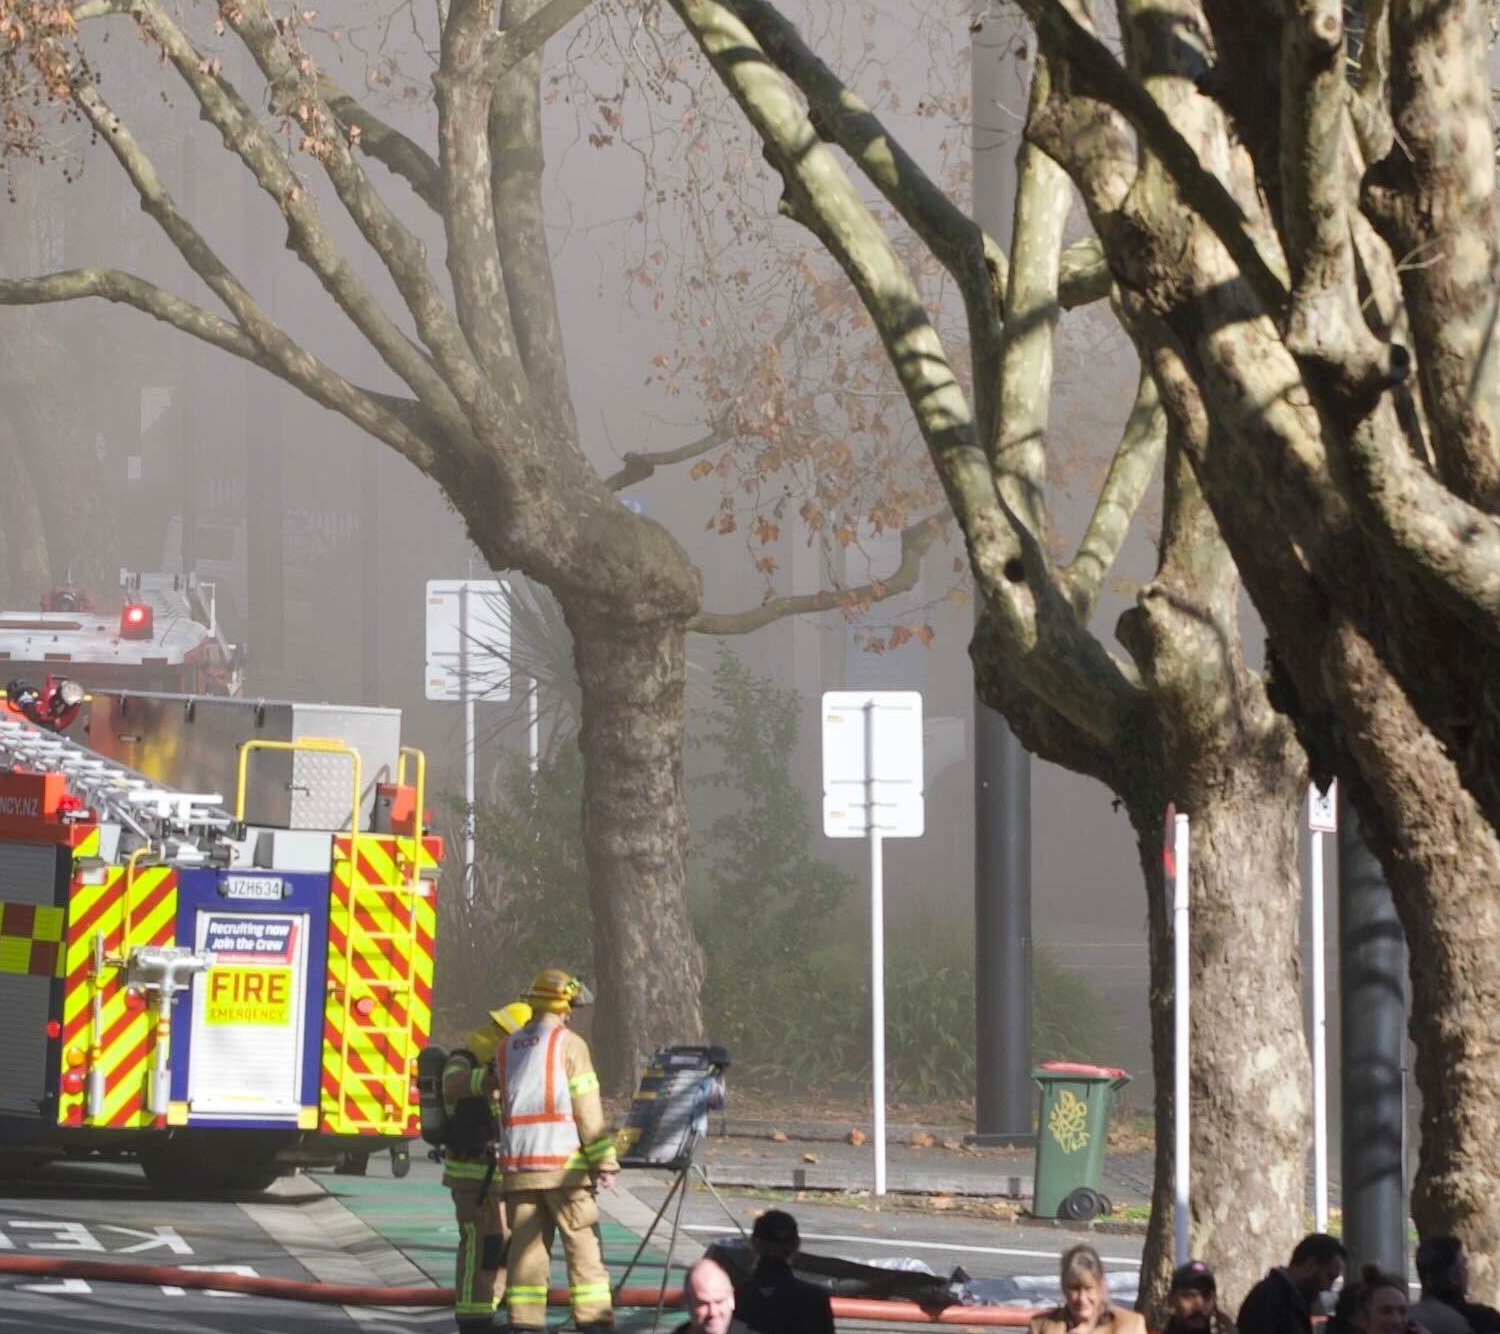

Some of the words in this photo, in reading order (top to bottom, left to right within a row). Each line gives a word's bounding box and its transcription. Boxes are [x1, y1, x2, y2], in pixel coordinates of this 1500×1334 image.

[230, 879, 280, 896] JZH634
[210, 922, 263, 937] Recruiting
[265, 924, 290, 936] now
[211, 937, 235, 950] Join
[236, 937, 255, 950] the
[256, 939, 284, 951] Crew
[211, 971, 286, 1004] FIRE
[210, 1008, 285, 1020] EMERGENCY
